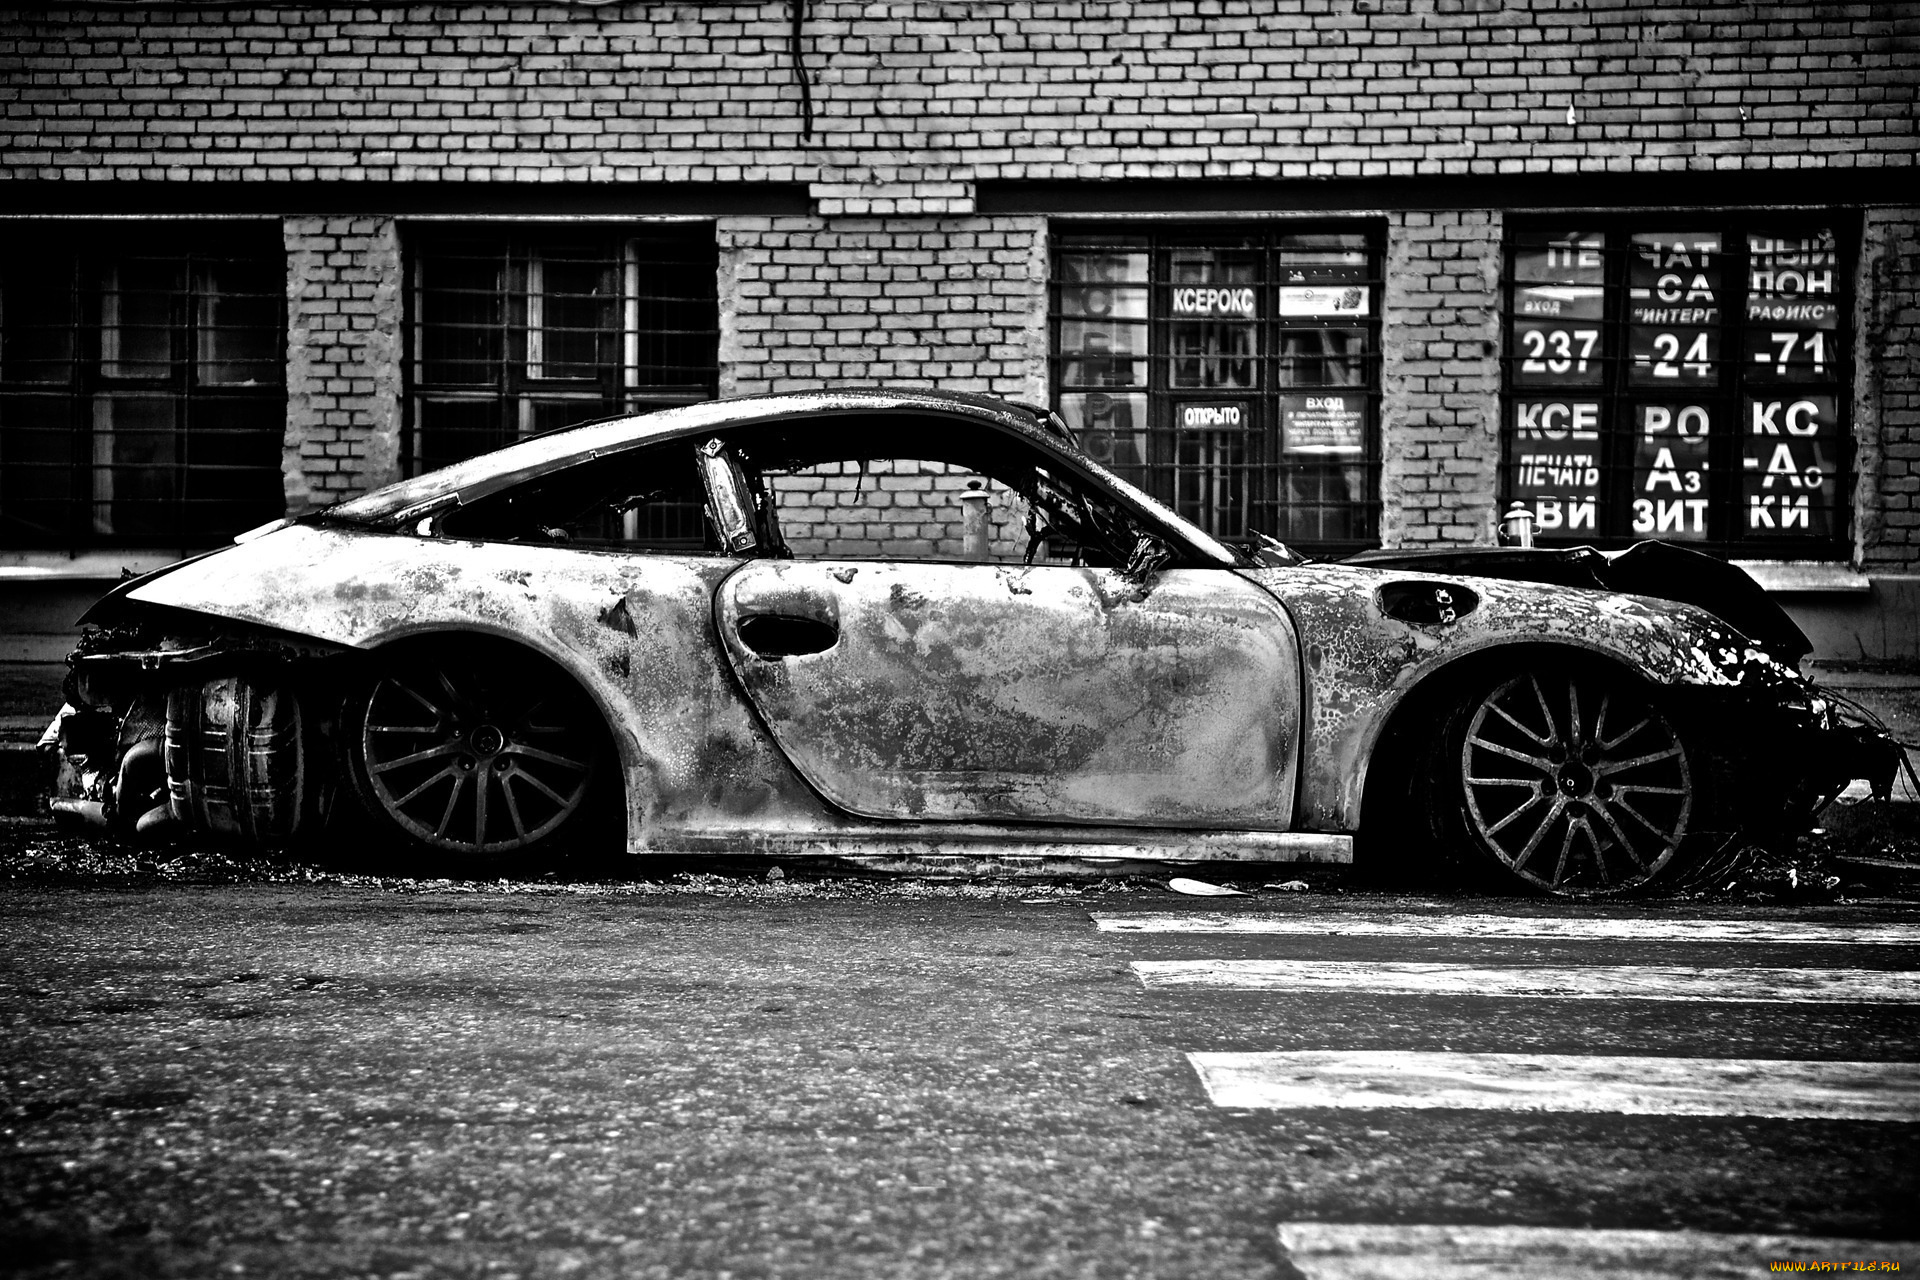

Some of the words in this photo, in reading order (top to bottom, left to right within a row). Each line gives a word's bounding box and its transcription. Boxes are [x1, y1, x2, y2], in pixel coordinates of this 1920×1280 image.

[1173, 288, 1255, 312] КСЕРОКС
[1524, 301, 1561, 314] ВХОД
[1522, 330, 1599, 373] 237
[1184, 406, 1240, 426] ОТКРЫТО
[1306, 397, 1344, 411] ВХОД
[1517, 403, 1599, 440] КСЕ
[1645, 405, 1710, 444] РО
[1753, 401, 1820, 437] КС
[1518, 454, 1600, 486] ПЕЧАТЬ
[1536, 495, 1596, 529] ВИ
[1632, 498, 1709, 532] ЗИТ
[1750, 494, 1809, 529] КИ
